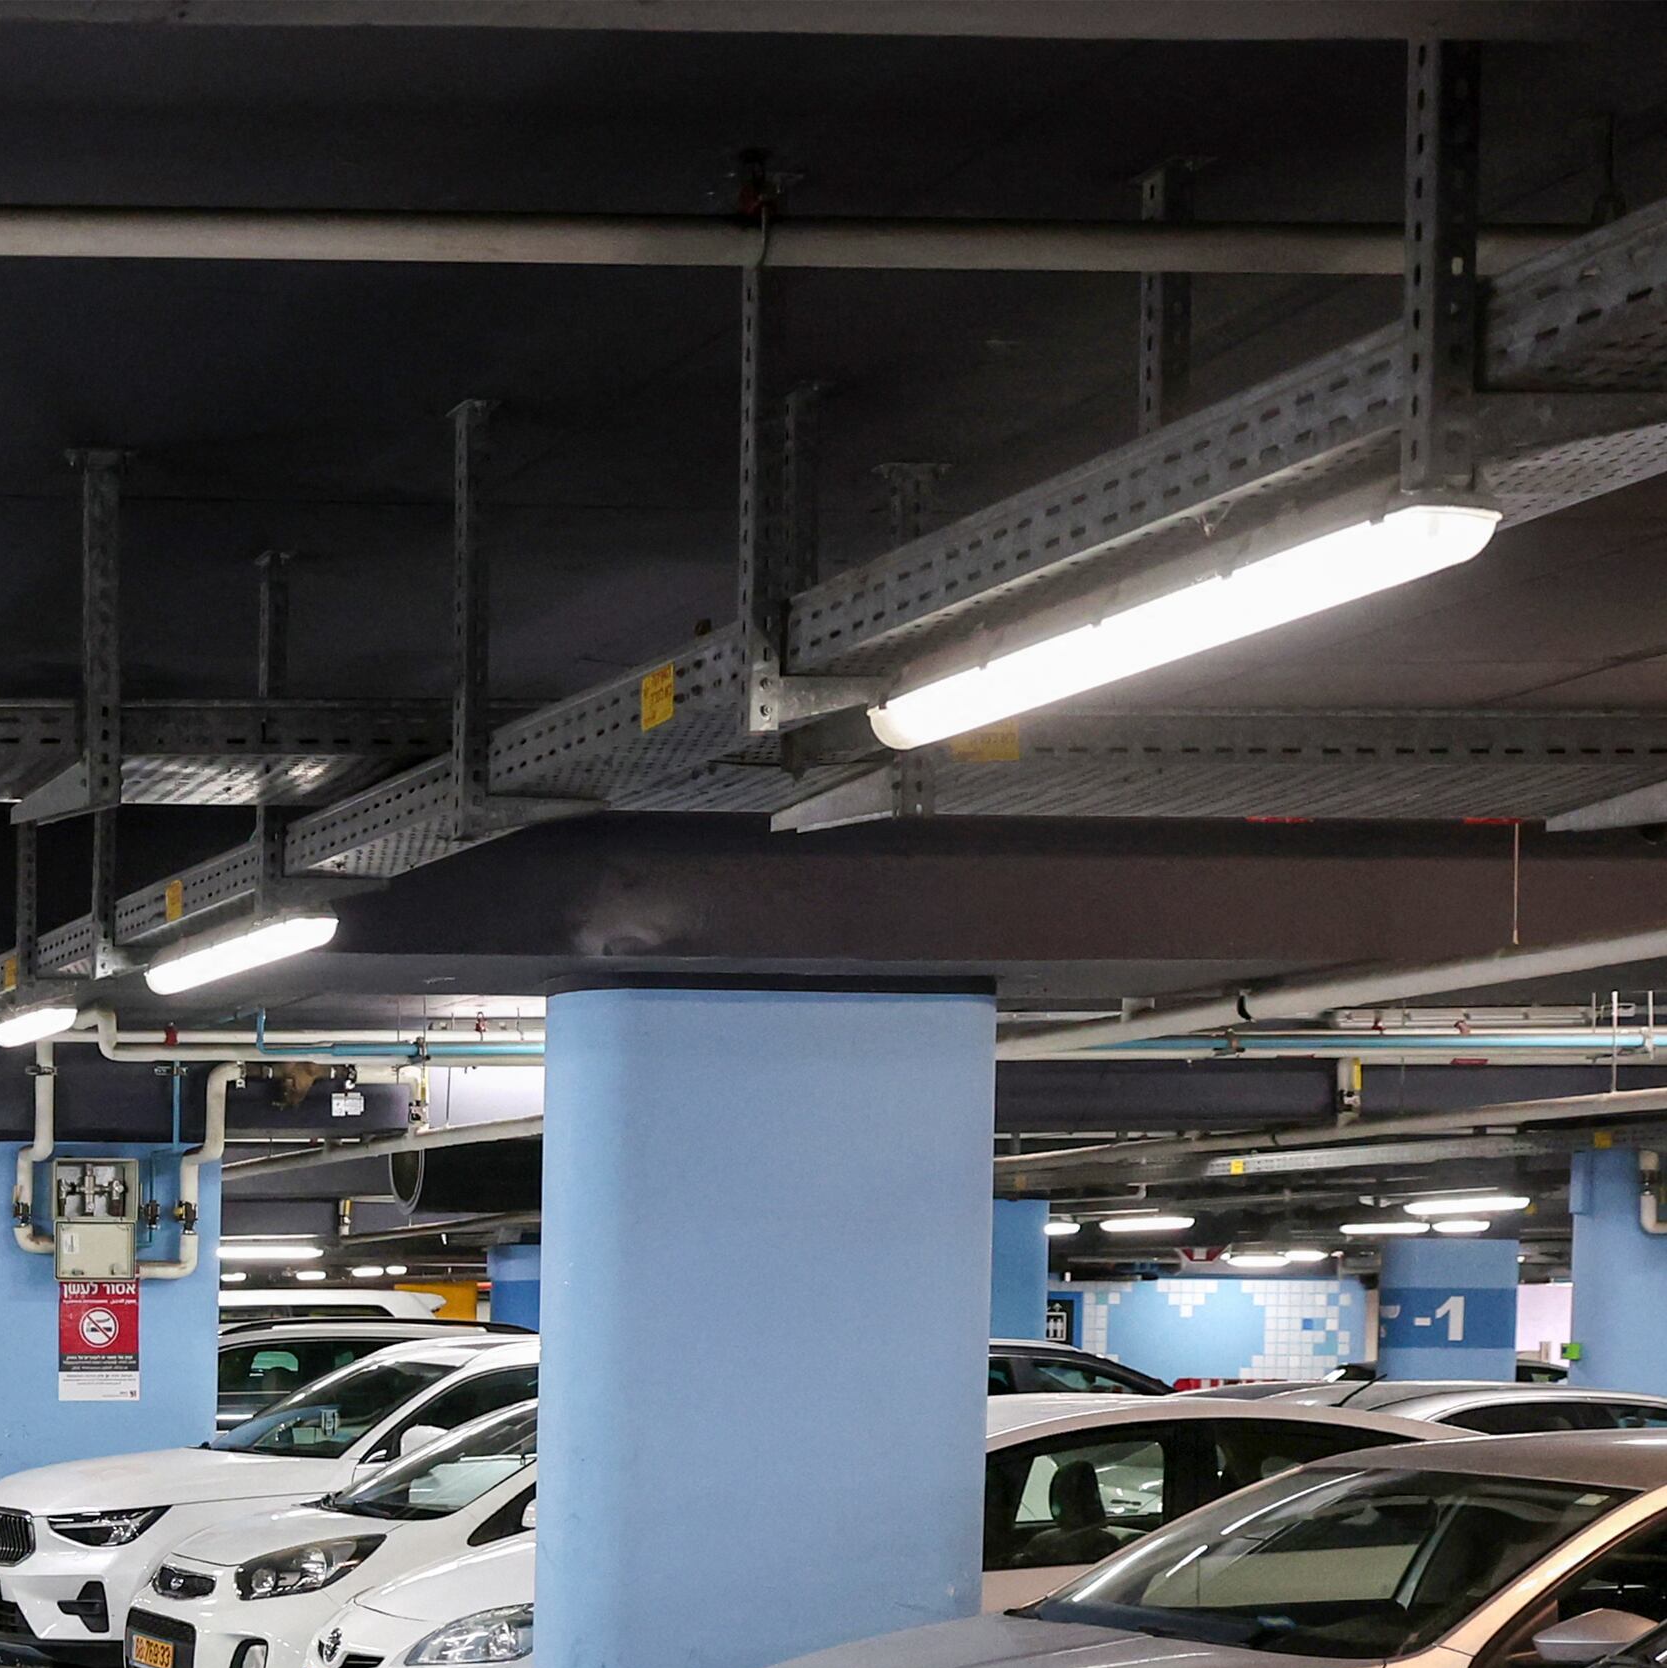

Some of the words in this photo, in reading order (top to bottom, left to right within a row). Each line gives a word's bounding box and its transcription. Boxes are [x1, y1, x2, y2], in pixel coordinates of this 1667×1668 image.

[62, 1281, 99, 1299] לעשן
[102, 1283, 137, 1295] אסור
[1413, 1296, 1465, 1341] -1
